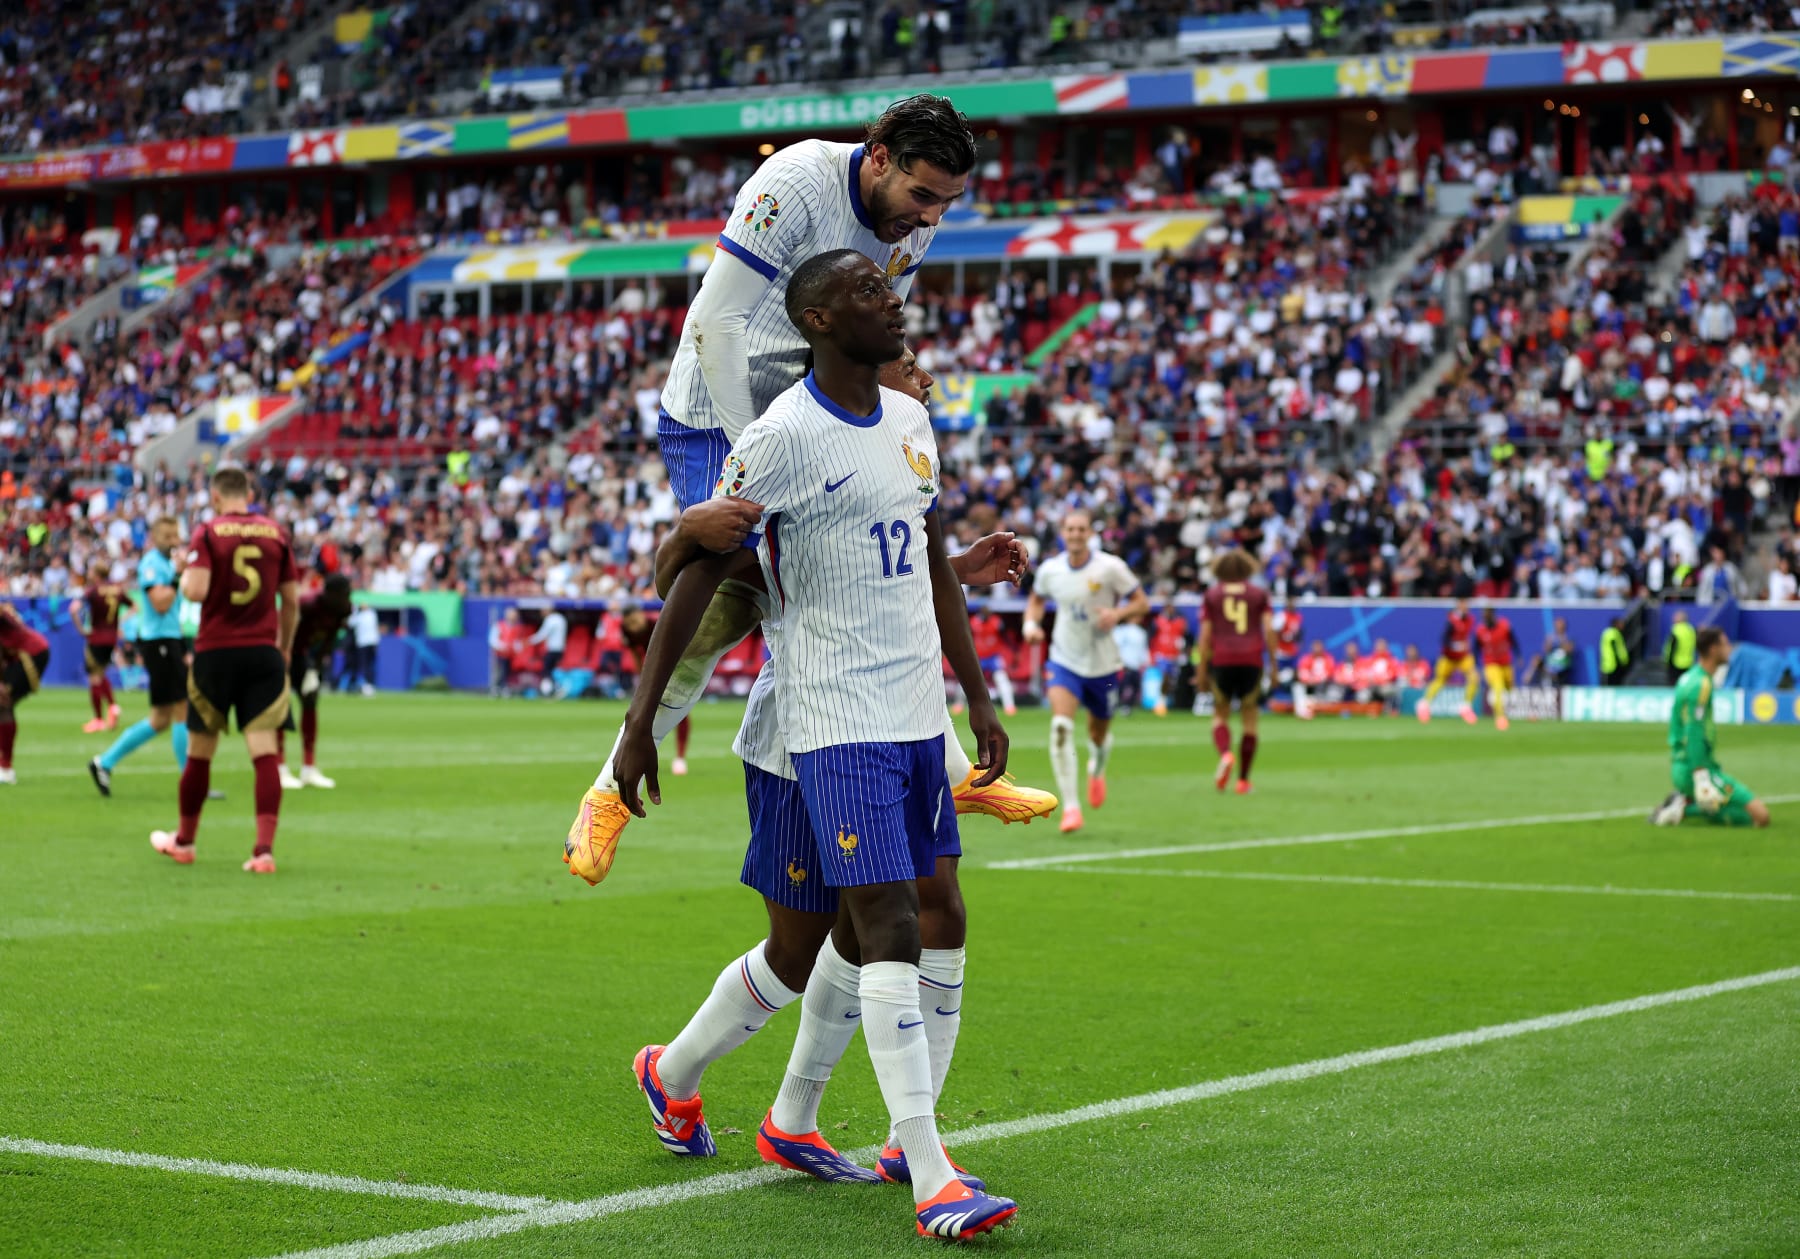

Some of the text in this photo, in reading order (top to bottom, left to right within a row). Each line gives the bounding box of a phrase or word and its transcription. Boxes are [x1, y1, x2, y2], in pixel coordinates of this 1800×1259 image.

[230, 544, 262, 605] 5
[869, 519, 913, 578] 12
[1223, 596, 1248, 634] 4
